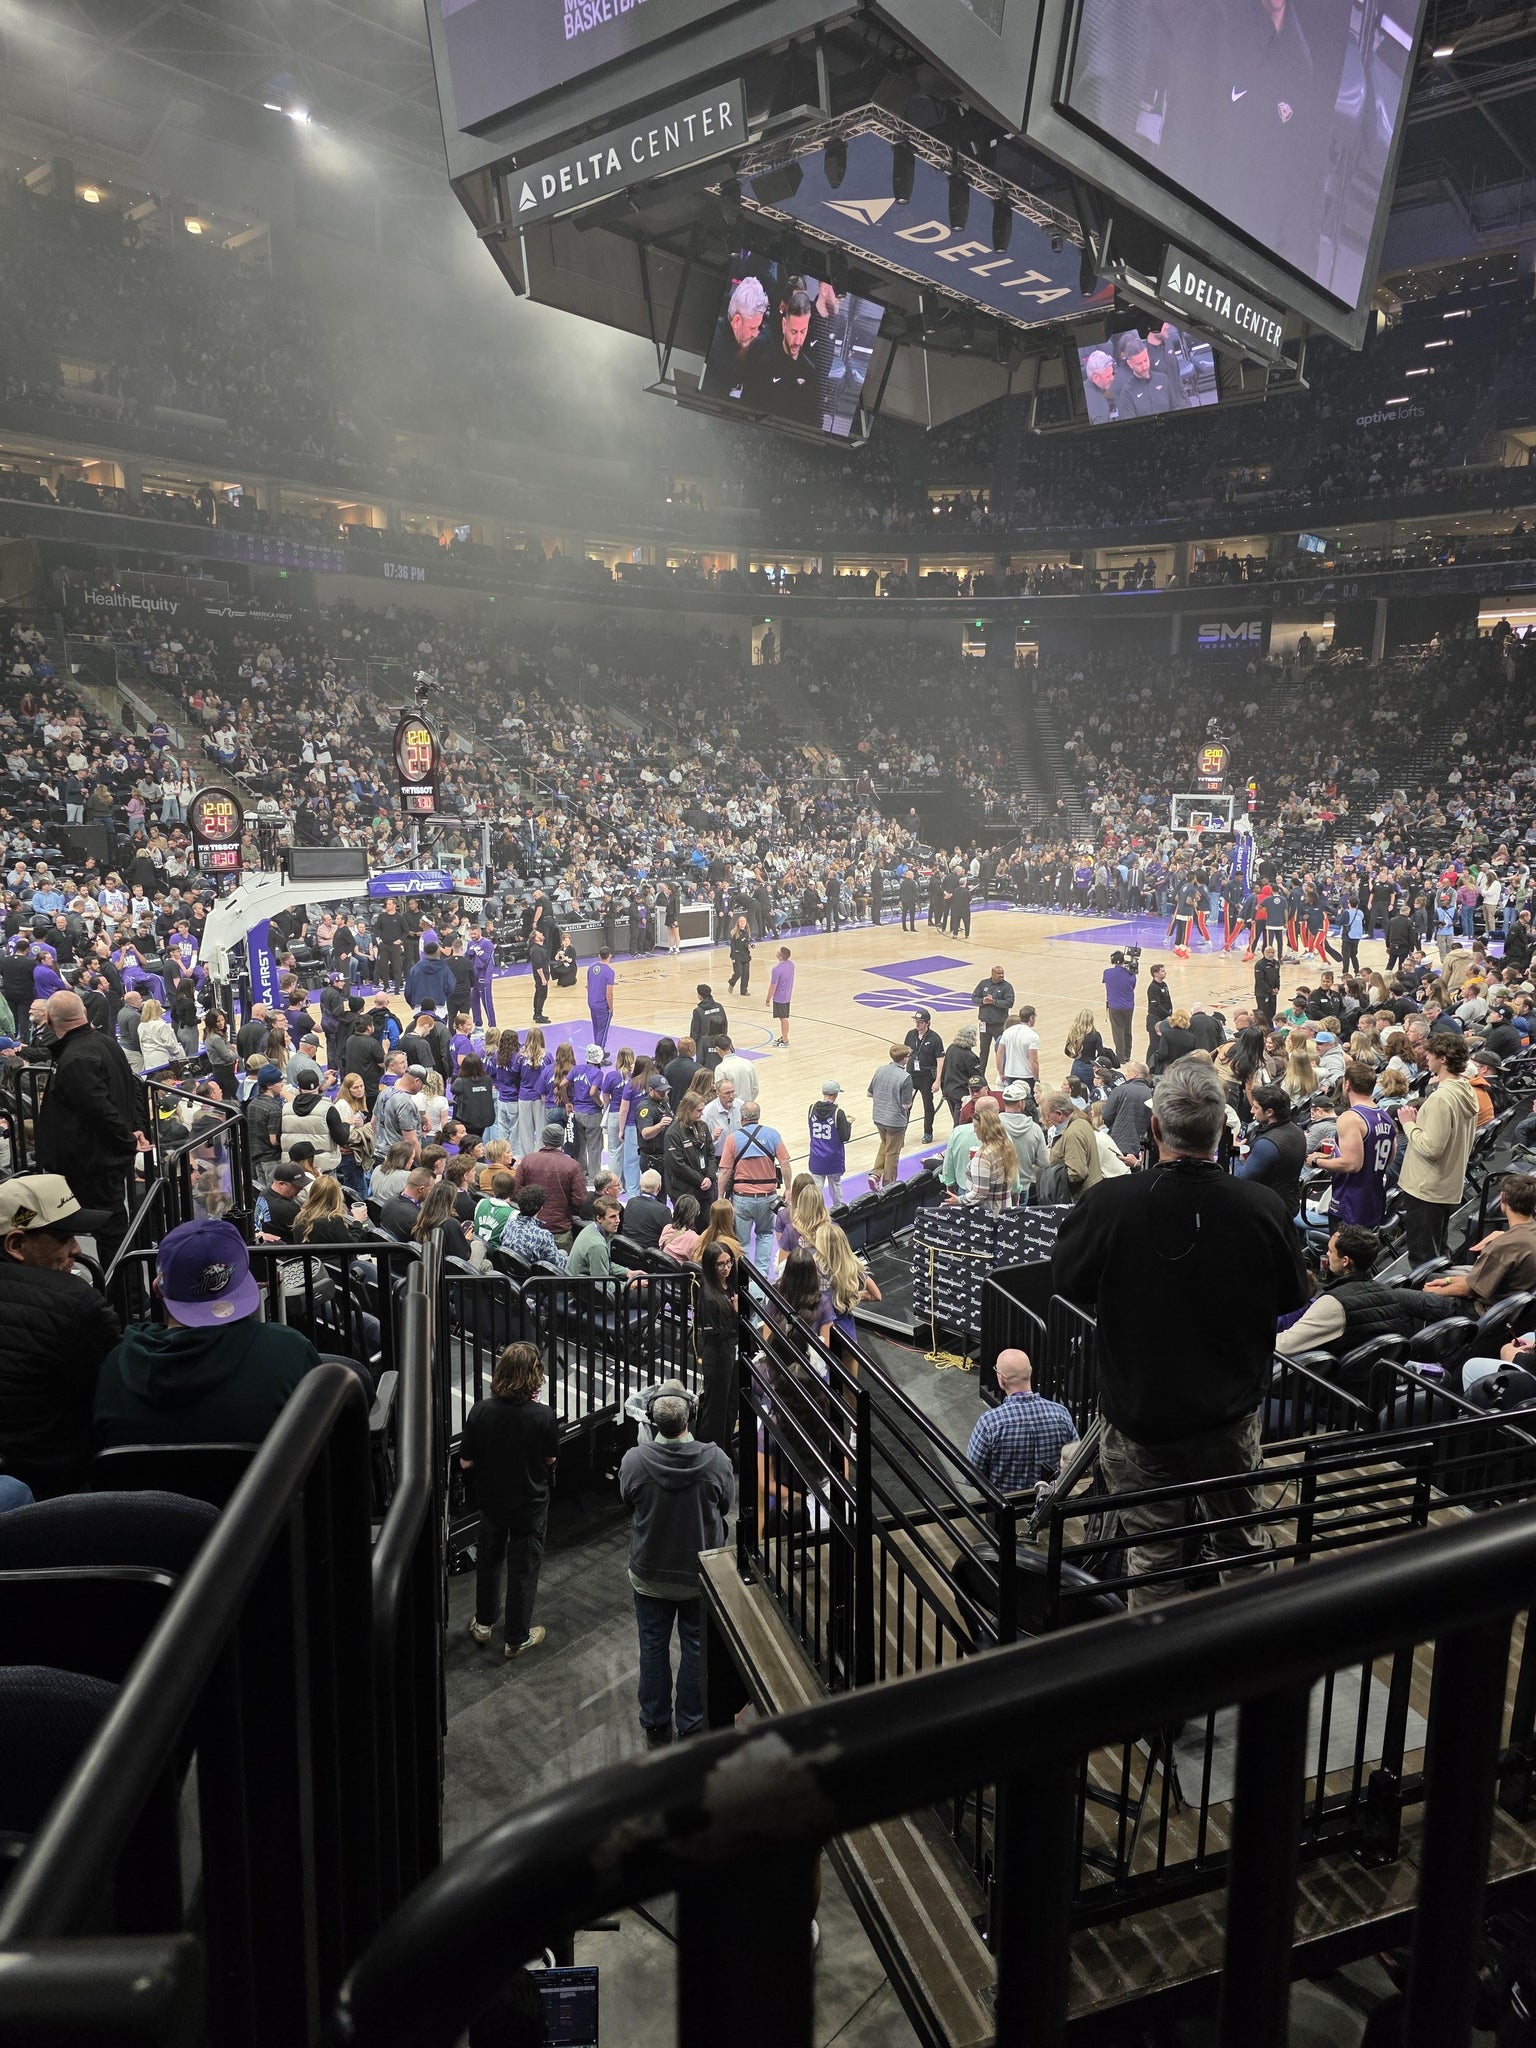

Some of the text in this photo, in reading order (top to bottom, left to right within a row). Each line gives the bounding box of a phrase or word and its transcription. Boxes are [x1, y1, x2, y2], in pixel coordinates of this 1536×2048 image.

[564, 0, 648, 40] BASKETB
[541, 101, 733, 200] DELTA CENTER
[894, 220, 1072, 305] DELTA
[1184, 272, 1282, 347] DELTA CENTER
[1356, 404, 1425, 428] aptive lofts
[384, 562, 424, 581] 07:36 PM
[84, 590, 178, 615] HealthEquity
[1198, 621, 1262, 642] SME
[1202, 758, 1221, 772] 24
[204, 803, 232, 816] 12:00
[204, 816, 228, 832] 24
[258, 948, 272, 987] FIRST
[812, 1122, 832, 1140] 23
[1374, 1139, 1392, 1172] 19
